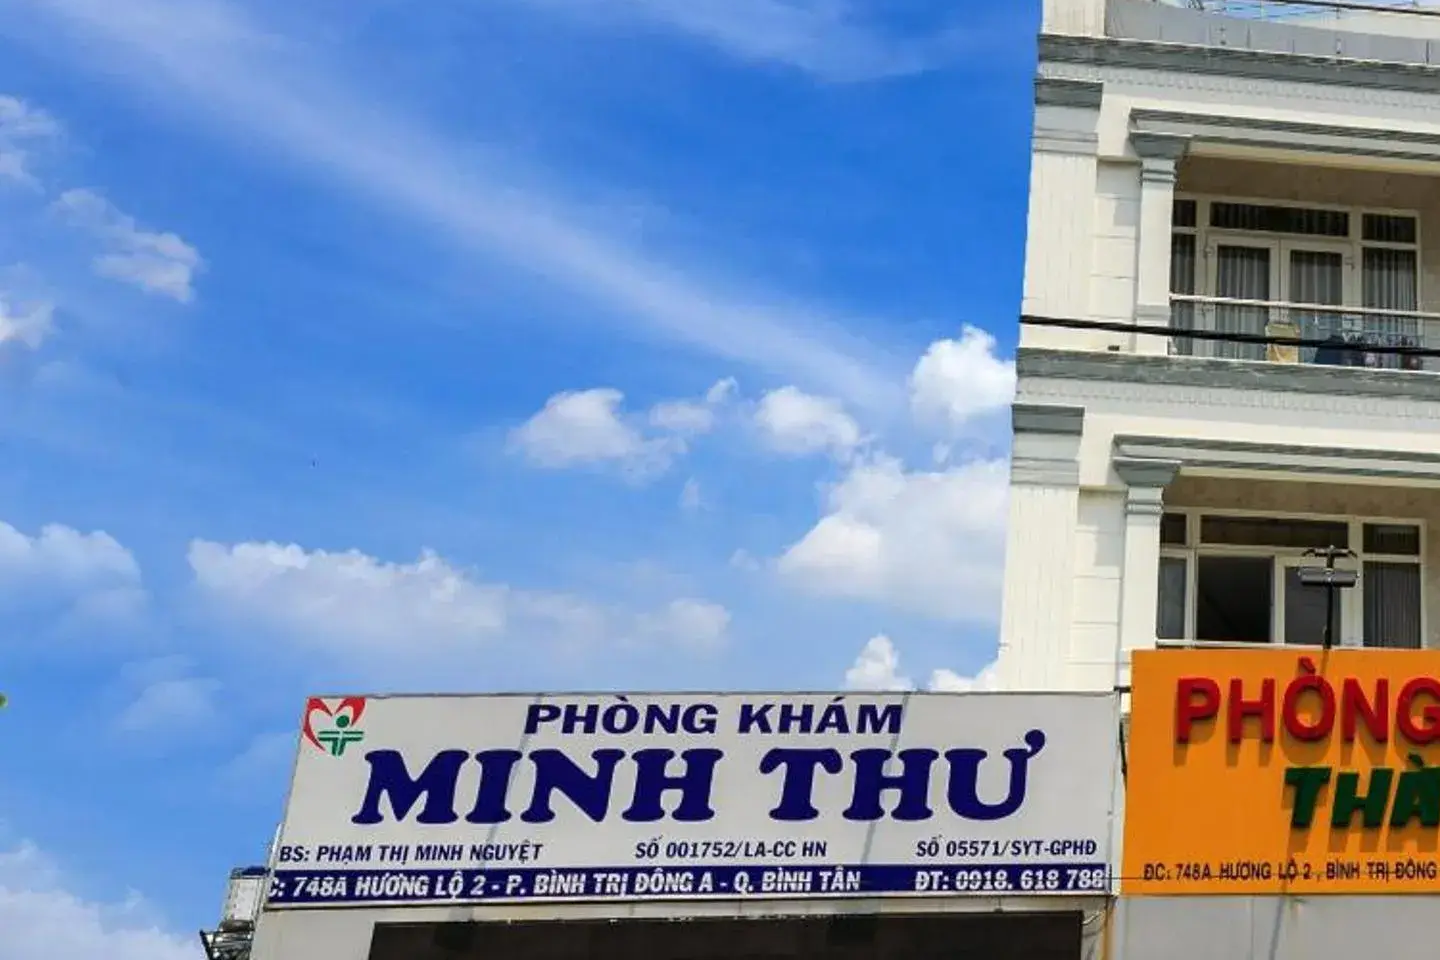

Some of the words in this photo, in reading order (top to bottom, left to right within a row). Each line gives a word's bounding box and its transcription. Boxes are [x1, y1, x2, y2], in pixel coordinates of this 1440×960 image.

[523, 695, 719, 735] PHÒNG
[737, 695, 904, 735] KHÁM
[351, 748, 725, 825] MINH
[758, 728, 1047, 822] THƯ
[279, 844, 311, 863] BS:
[316, 844, 374, 865] PHẠM
[379, 844, 409, 865] THỊ
[414, 843, 464, 862] MINH
[469, 839, 544, 864] NGUYỆT
[635, 834, 663, 858] SỐ
[665, 840, 796, 859] 001752/LA-CC
[801, 840, 828, 858] HN
[915, 833, 943, 857] SỐ
[945, 839, 1097, 858] 05571/SYT-GPHĐ
[293, 876, 347, 898] 748A
[354, 871, 430, 897] HƯƠNG
[434, 870, 464, 900] LỘ
[469, 874, 487, 896] 2
[505, 874, 527, 895] P.
[533, 869, 586, 895] BÌNH
[592, 872, 628, 898] TRỊ
[634, 868, 694, 893] ĐÔNG
[698, 871, 714, 893] A
[733, 871, 754, 895] Q.
[761, 866, 813, 892] BÌNH
[819, 864, 862, 891] TÂN
[914, 871, 949, 891] ĐT:
[954, 869, 1014, 891] 0918.
[1019, 869, 1060, 890] 618
[1143, 863, 1172, 881] ĐC:
[1175, 862, 1212, 881] 748A
[1325, 858, 1360, 881] BÌNH
